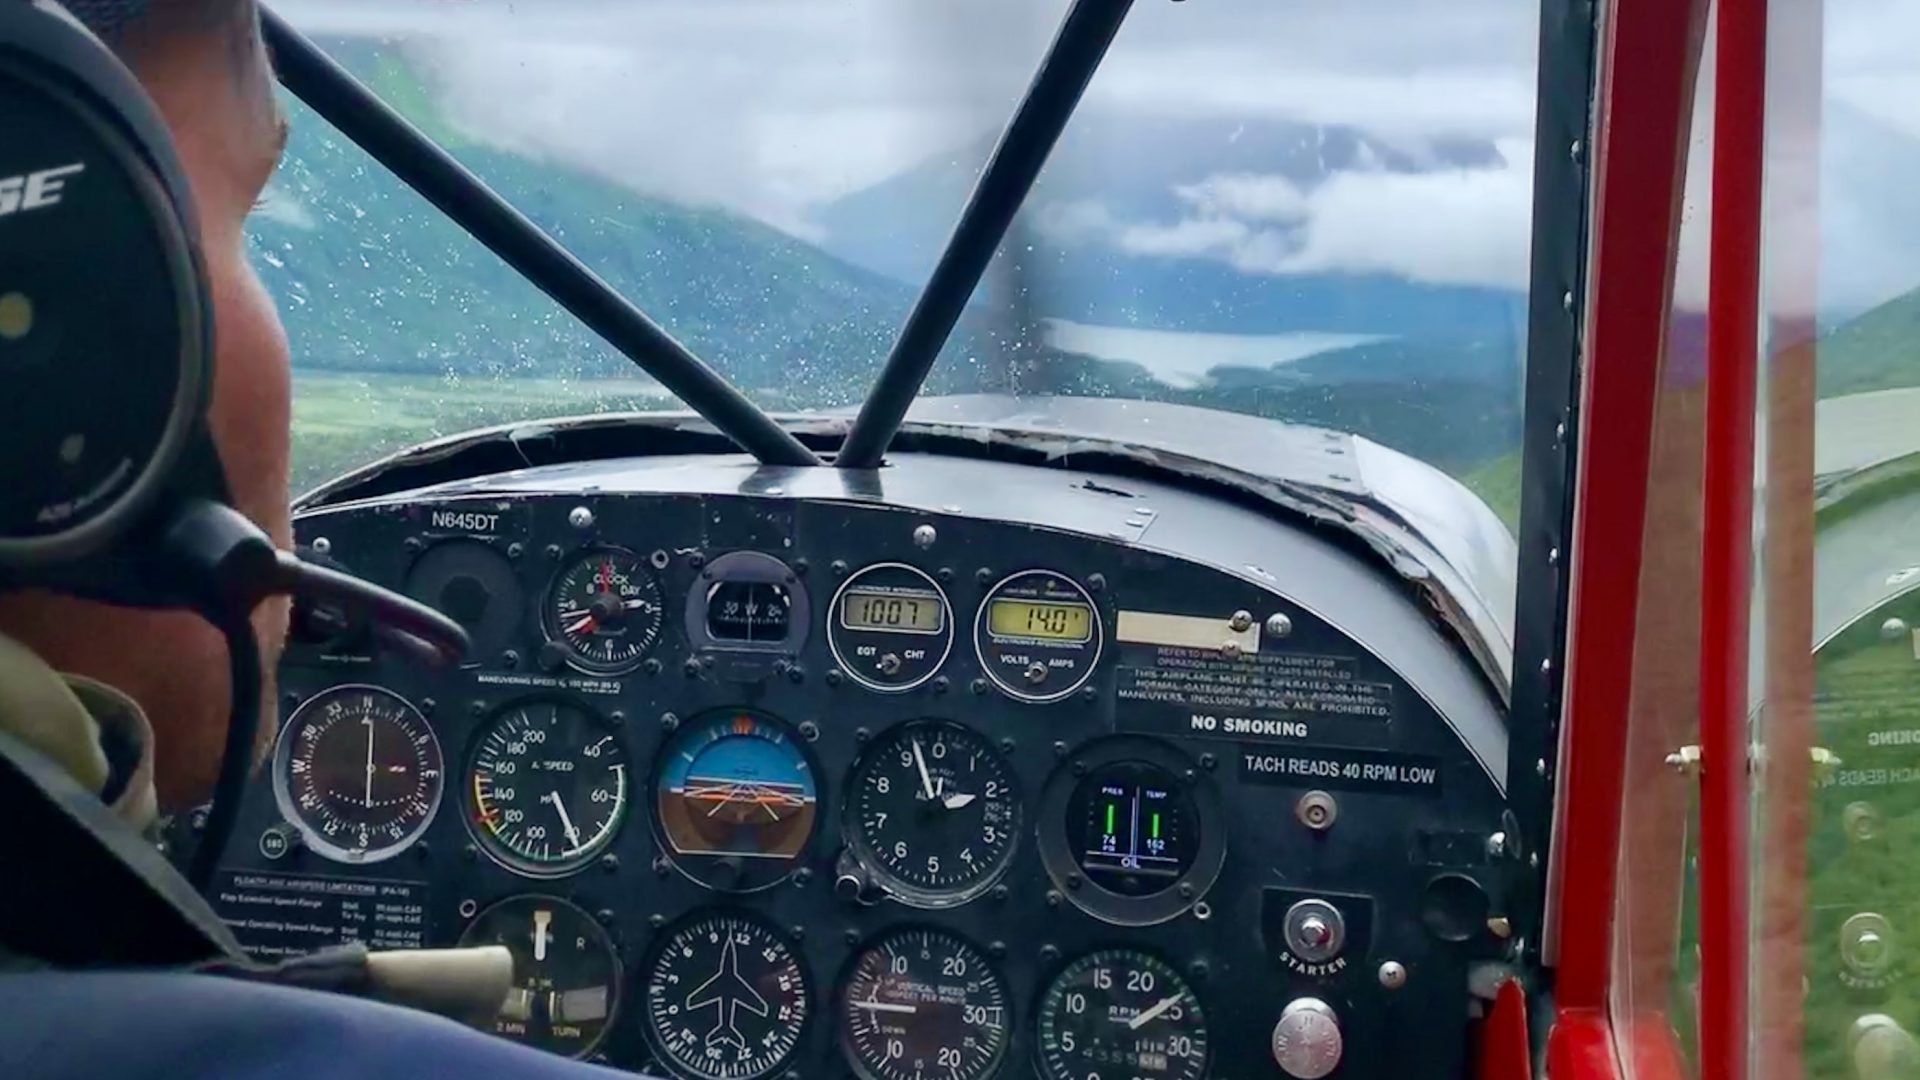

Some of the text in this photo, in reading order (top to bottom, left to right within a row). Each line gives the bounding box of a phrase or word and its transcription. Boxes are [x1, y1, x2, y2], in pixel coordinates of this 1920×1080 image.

[432, 512, 498, 531] N645DT
[745, 603, 758, 616] W
[863, 600, 918, 625] 1007
[857, 647, 925, 659] EGT CHT
[1000, 654, 1074, 668] VOLTS AMPS
[1157, 657, 1206, 669] OPERATION
[1136, 680, 1179, 690] NORMAL
[1184, 682, 1240, 694] CATEGORY
[1162, 671, 1213, 682] AIRPLANE
[1220, 674, 1247, 684] MUST
[1270, 678, 1331, 690] OPERATED
[1191, 692, 1250, 706] INCLUDING
[1293, 701, 1316, 711] ARE
[1191, 715, 1308, 737] NO SMOKING
[522, 730, 546, 744] 200
[507, 742, 527, 755] 180
[583, 746, 601, 758] 40
[932, 743, 946, 759] 0
[900, 751, 913, 767] 9
[969, 755, 975, 772] 1
[496, 762, 516, 774] 160
[1245, 755, 1436, 784] TACH READS 40 RPM LOW
[876, 776, 890, 793] 8
[985, 781, 998, 798] 2
[494, 788, 515, 800] 140
[591, 789, 608, 803] 60
[1146, 790, 1167, 799] TEMP
[505, 810, 523, 822] 120
[875, 812, 888, 829] 7
[526, 827, 546, 839] 100
[983, 826, 996, 843] 3
[894, 841, 907, 858] 6
[959, 847, 972, 863] 4
[927, 856, 940, 873] 5
[576, 937, 585, 949] R
[735, 932, 751, 946] 12
[682, 947, 693, 958] 6
[762, 948, 778, 963] 15
[891, 956, 908, 974] 10
[942, 958, 966, 976] 20
[1279, 951, 1347, 976] STARTER
[668, 974, 679, 984] 3
[1093, 968, 1112, 990] 15
[1127, 970, 1155, 992] 20
[1066, 993, 1086, 1014] 10
[1108, 1005, 1140, 1017] RPM
[962, 1005, 987, 1025] 30
[506, 1023, 526, 1036] MIN
[552, 1027, 581, 1038] TURN
[887, 1039, 904, 1058] 10
[1062, 1031, 1075, 1052] 5
[1167, 1036, 1191, 1057] 30
[937, 1047, 961, 1068] 20
